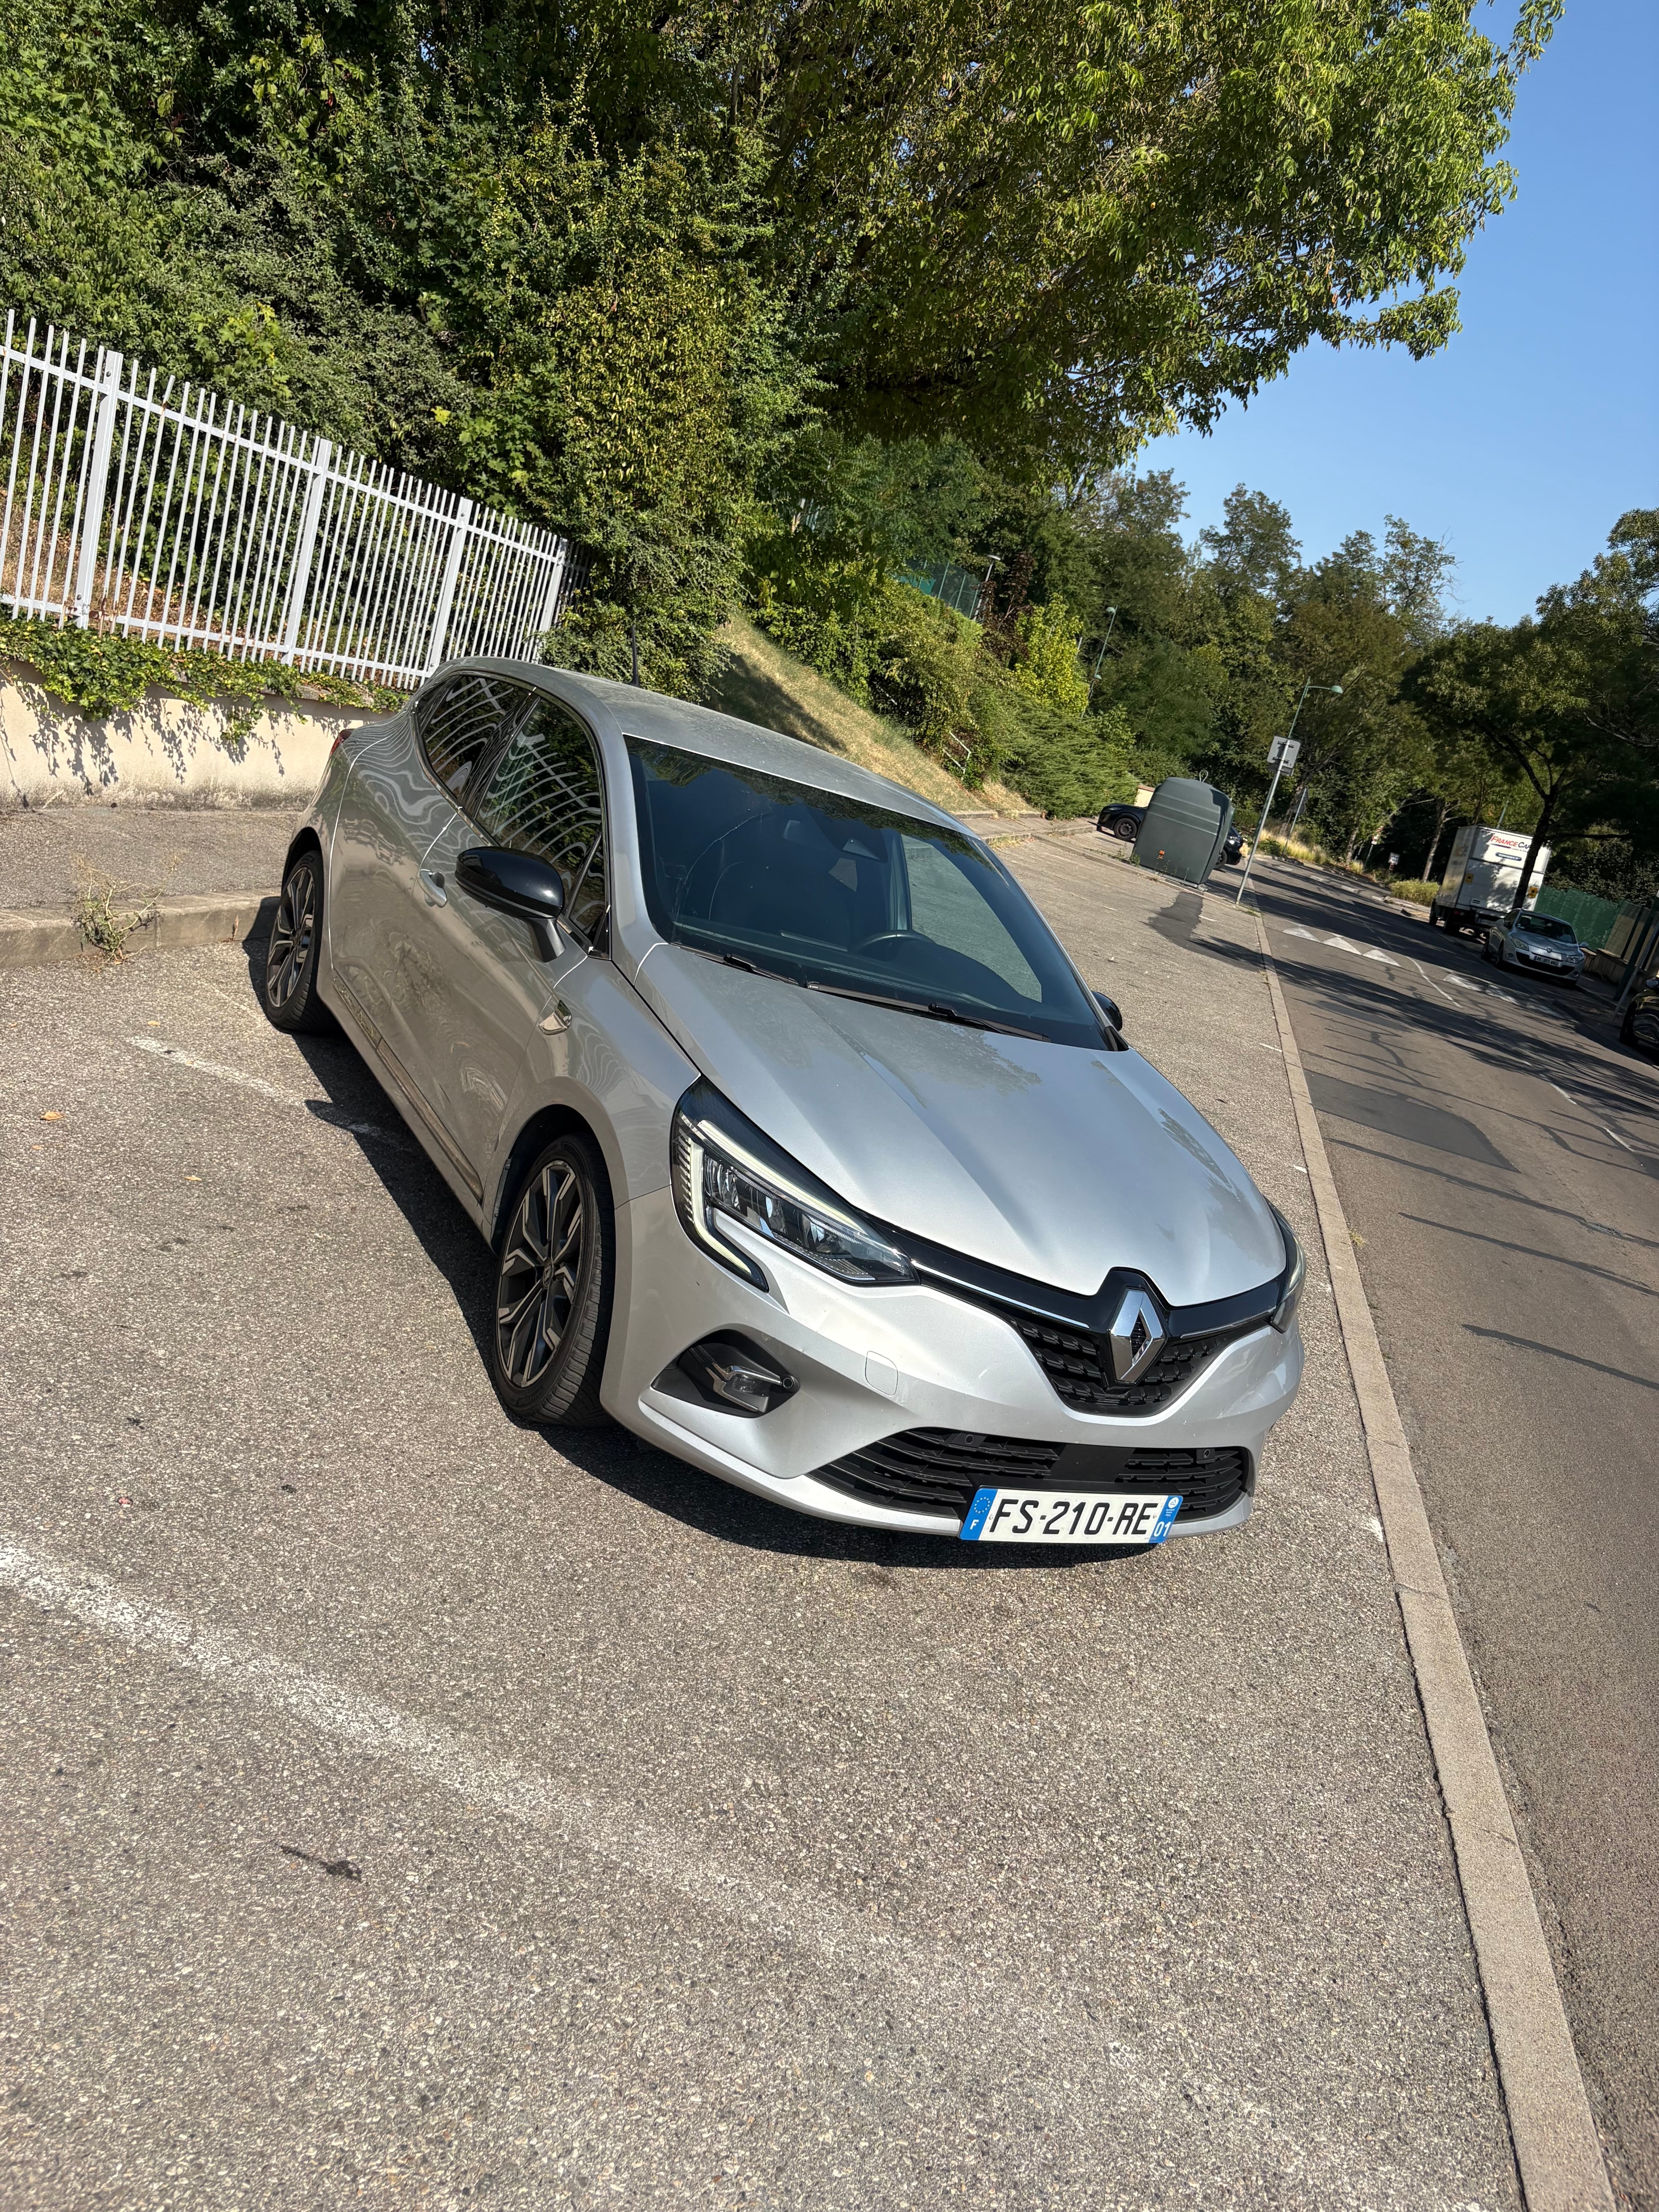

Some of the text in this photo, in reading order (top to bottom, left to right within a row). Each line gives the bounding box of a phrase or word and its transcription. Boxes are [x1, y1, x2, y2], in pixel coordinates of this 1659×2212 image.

[1491, 836, 1518, 847] FRANCE
[970, 1519, 979, 1530] F
[989, 1499, 1158, 1535] FS-210-RE
[1154, 1521, 1171, 1537] 01
